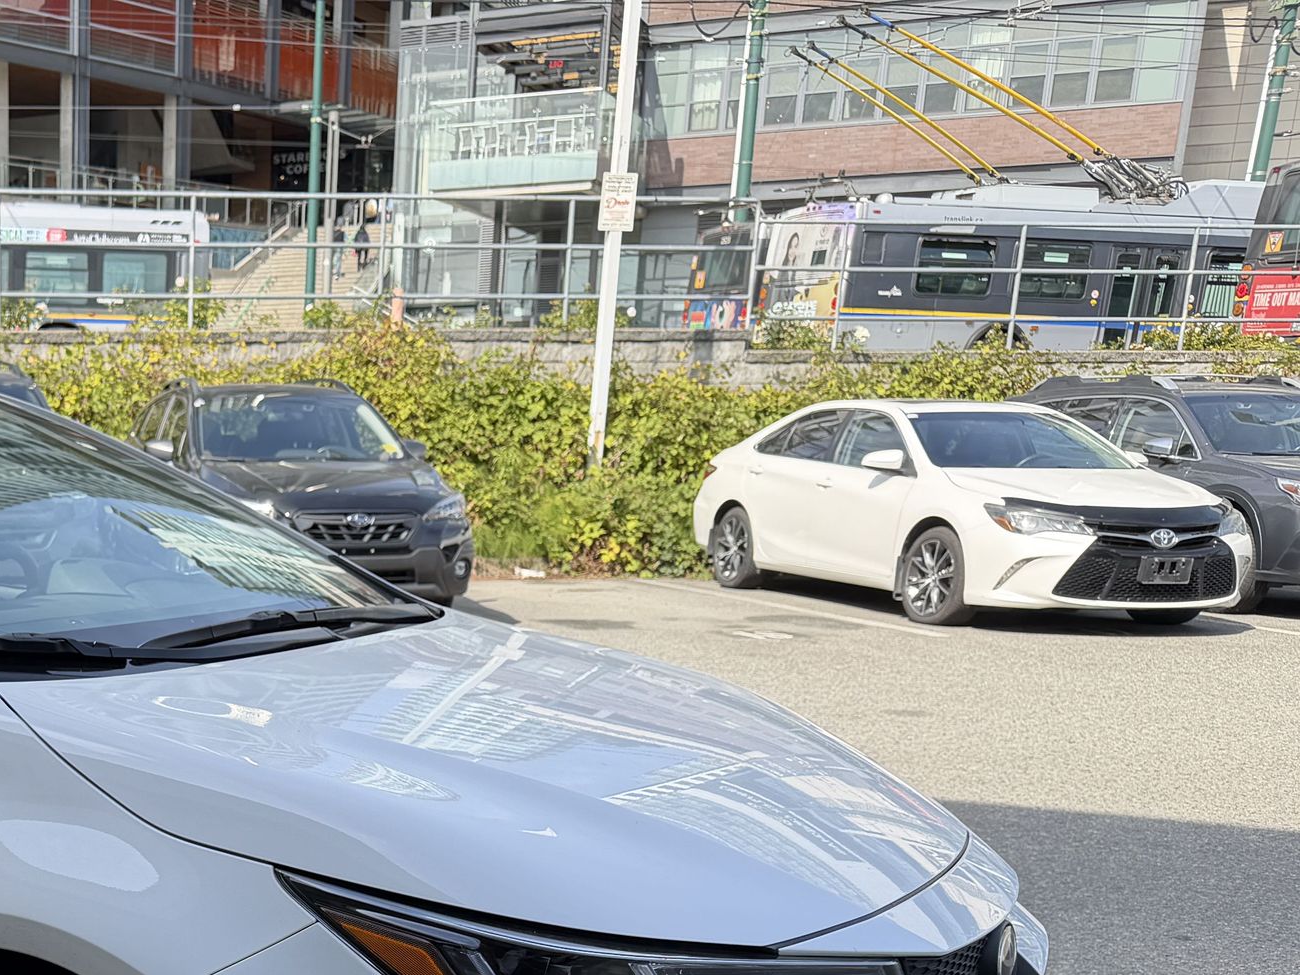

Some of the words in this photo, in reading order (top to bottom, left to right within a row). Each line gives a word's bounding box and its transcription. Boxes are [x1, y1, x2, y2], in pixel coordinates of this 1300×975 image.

[273, 150, 347, 165] STARCS
[1253, 292, 1273, 307] TIME
[1271, 292, 1288, 306] OUT
